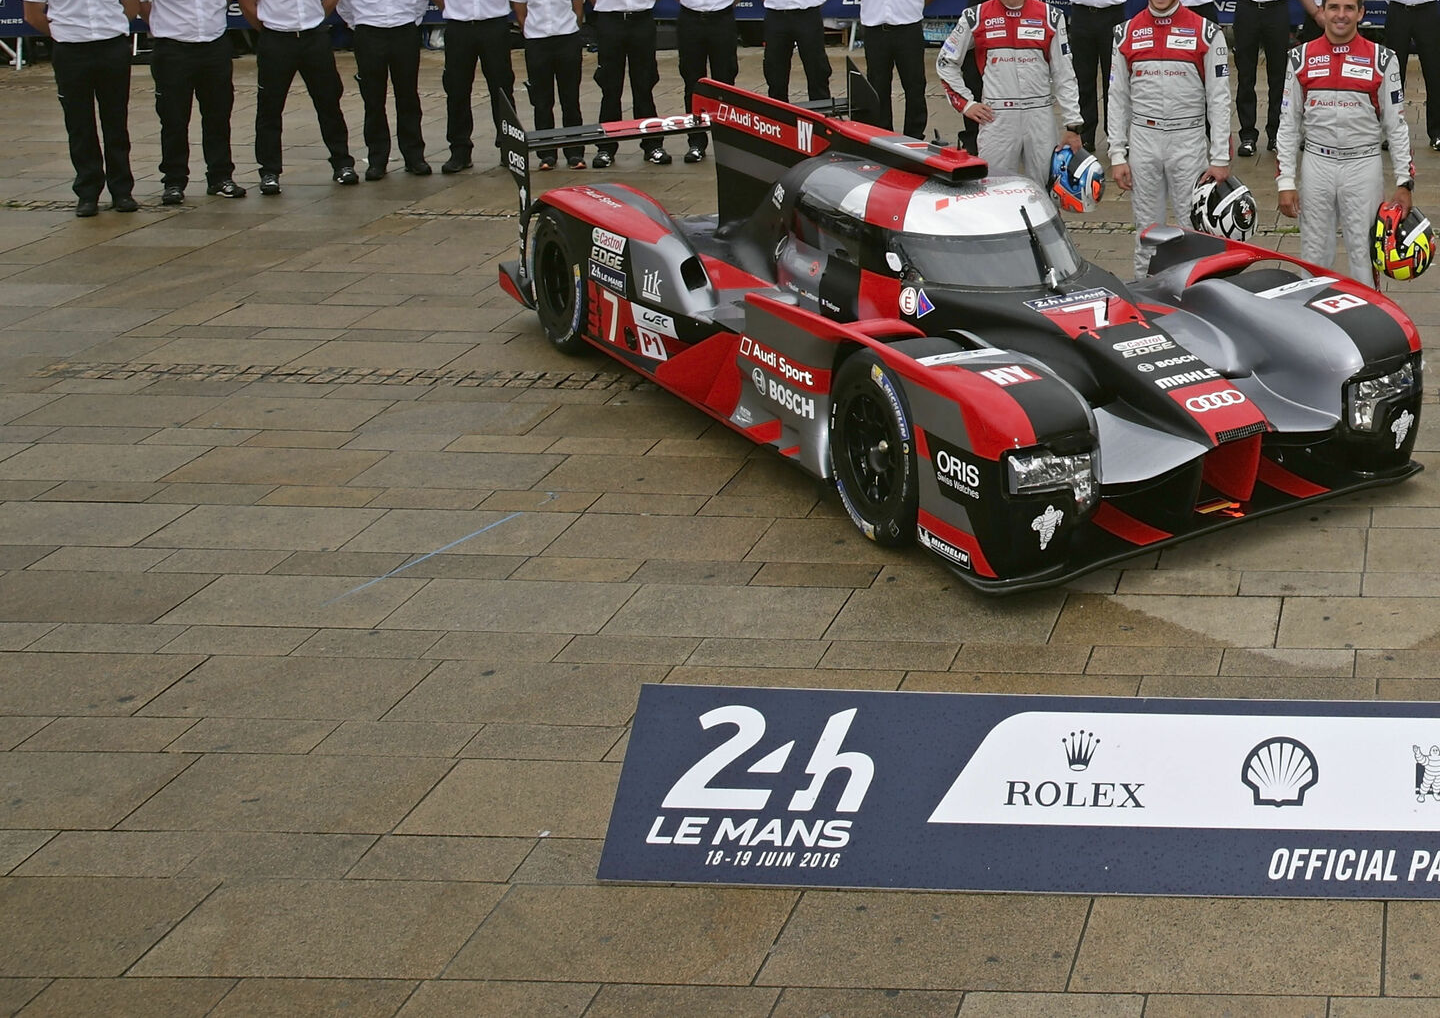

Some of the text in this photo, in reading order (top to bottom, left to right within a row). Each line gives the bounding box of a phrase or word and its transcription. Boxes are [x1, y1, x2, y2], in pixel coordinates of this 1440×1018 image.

[985, 17, 1005, 26] ORIS
[1132, 27, 1153, 37] ORIS
[1308, 55, 1330, 65] ORIS
[1164, 69, 1187, 77] Sport
[1338, 100, 1361, 108] Sport
[508, 125, 525, 142] BOSCH
[729, 108, 781, 138] Audi Sport
[797, 120, 813, 153] HY
[508, 151, 525, 170] ORIS
[955, 186, 1036, 203] Audi Sport
[600, 233, 623, 251] Castrol
[591, 246, 624, 270] EDGE
[601, 273, 608, 281] LE
[608, 275, 623, 288] MANS
[643, 269, 662, 296] itk
[1035, 290, 1106, 308] 24h LE MANS
[1322, 295, 1358, 309] P1
[603, 289, 618, 342] 7
[643, 312, 668, 328] WEC
[1061, 300, 1109, 327] 7
[642, 332, 662, 355] P1
[1122, 341, 1176, 358] EDGE
[1126, 335, 1162, 348] Castrol
[753, 343, 814, 385] Audi Sport
[1155, 354, 1199, 368] BOSCH
[980, 365, 1033, 386] HY
[1154, 368, 1220, 389] MAHLE
[769, 379, 815, 419] BOSCH
[883, 382, 908, 437] MICHELIN
[937, 450, 980, 487] ORIS
[937, 471, 980, 499] Swiss Watches
[930, 537, 969, 563] MICHELIN
[661, 704, 875, 812] 24h
[1003, 780, 1146, 809] ROLEX
[646, 816, 853, 848] LE MANS
[705, 851, 841, 868] 18-19 JUIN 2016
[1268, 848, 1398, 881] OFFICIAL
